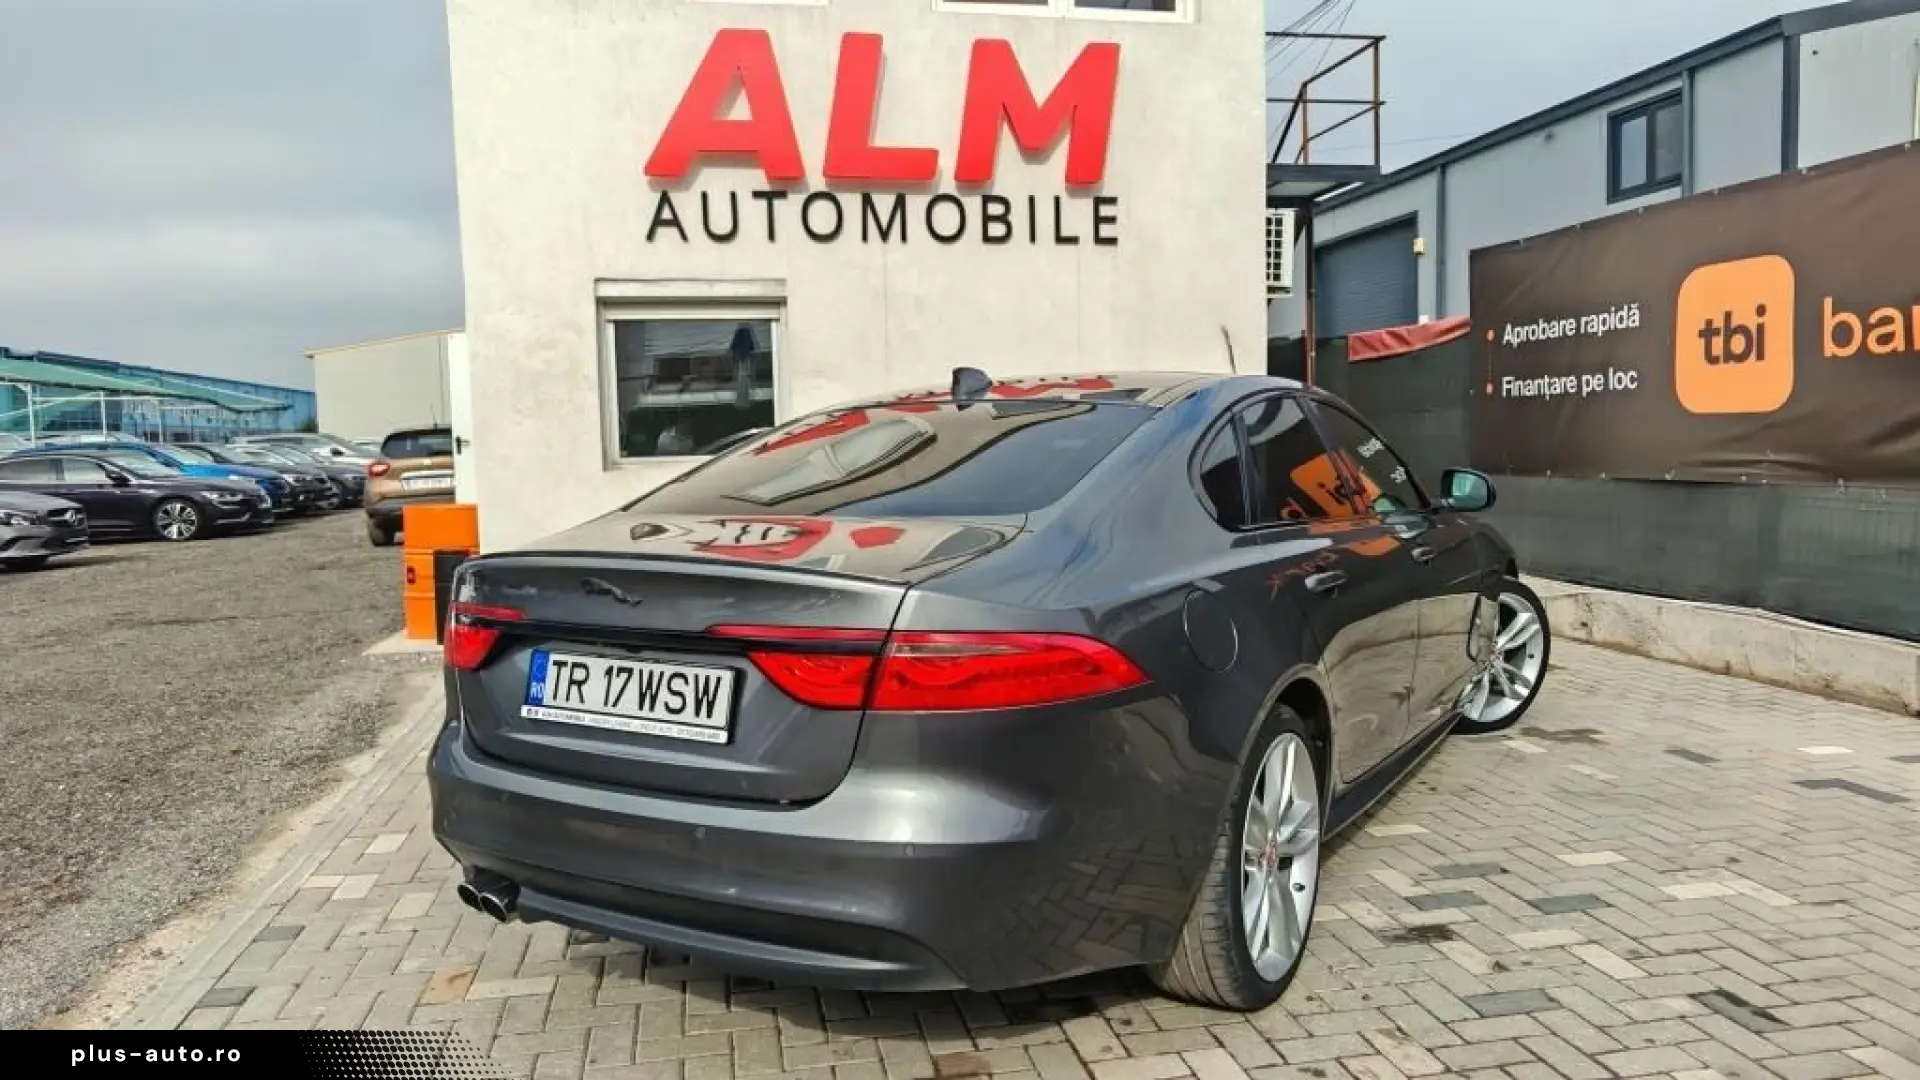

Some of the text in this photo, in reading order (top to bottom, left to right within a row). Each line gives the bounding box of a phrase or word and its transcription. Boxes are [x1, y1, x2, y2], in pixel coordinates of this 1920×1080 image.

[644, 28, 1121, 184] ALM
[646, 190, 1119, 246] AUTOMOBILE
[1502, 303, 1640, 348] Aprobare rapidă
[1698, 297, 1920, 366] tbi ba
[1501, 367, 1638, 400] Finanțare pe loc
[552, 659, 590, 704] TR
